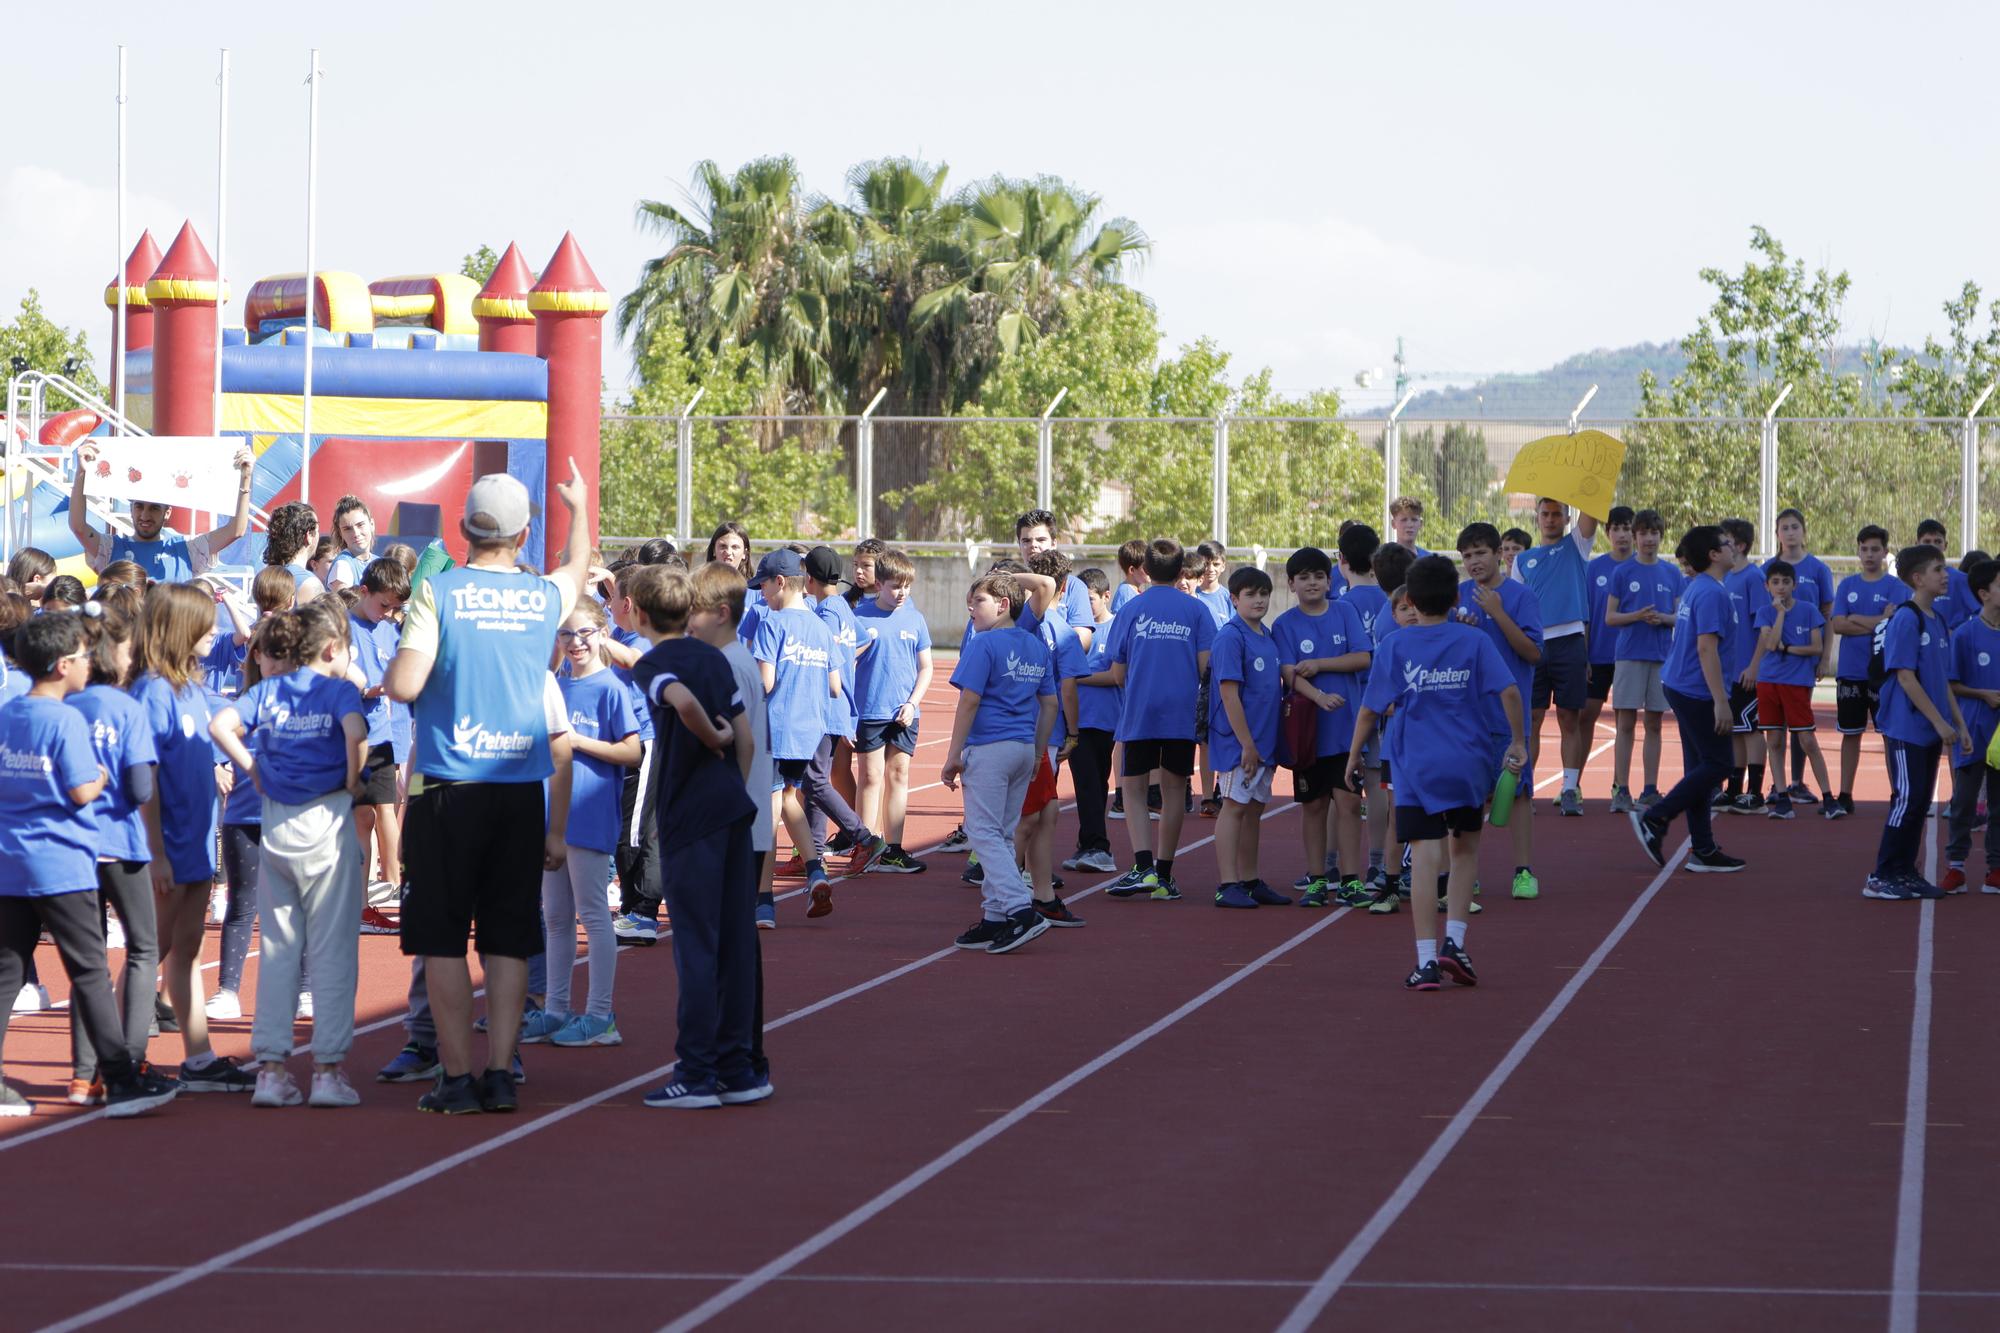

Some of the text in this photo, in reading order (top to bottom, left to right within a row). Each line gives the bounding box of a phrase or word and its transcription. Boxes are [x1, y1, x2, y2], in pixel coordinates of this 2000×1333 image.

[451, 582, 546, 612] TÉCNICO
[1149, 621, 1191, 636] Pebetero
[1419, 667, 1470, 685] Pebetero
